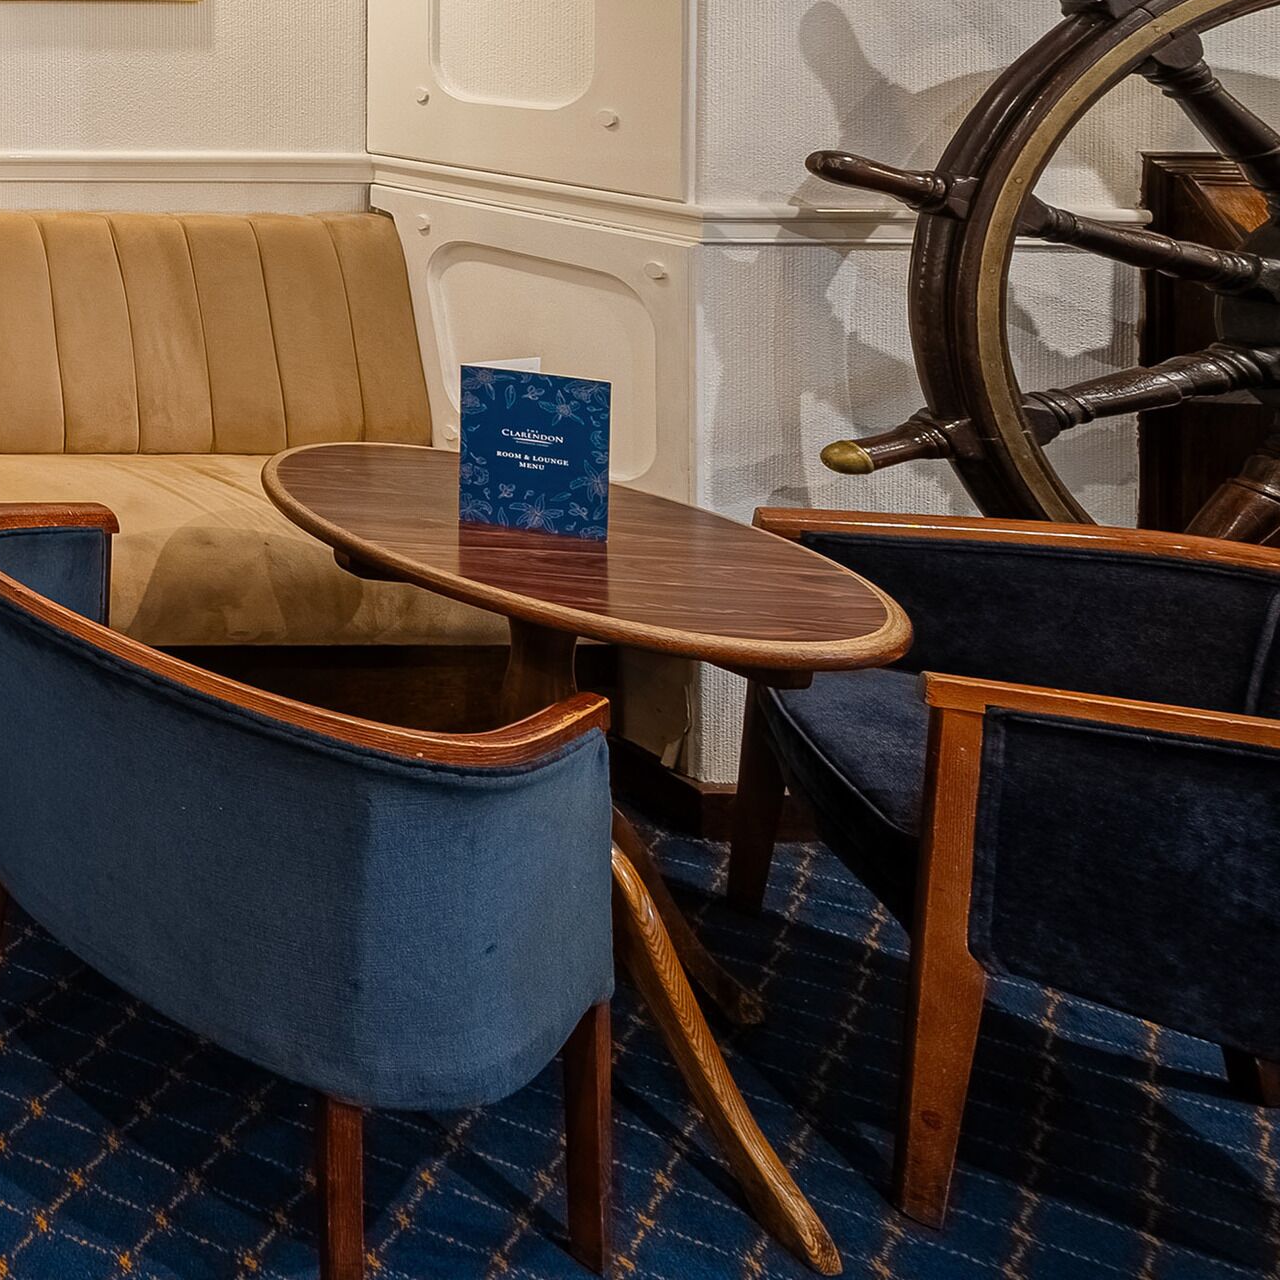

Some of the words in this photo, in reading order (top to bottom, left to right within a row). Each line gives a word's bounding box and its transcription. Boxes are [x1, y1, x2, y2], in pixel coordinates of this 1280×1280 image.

[501, 428, 564, 443] CLARENDON
[496, 450, 522, 459] ROOM
[532, 455, 569, 466] LOUNGE
[519, 461, 545, 470] MENU
